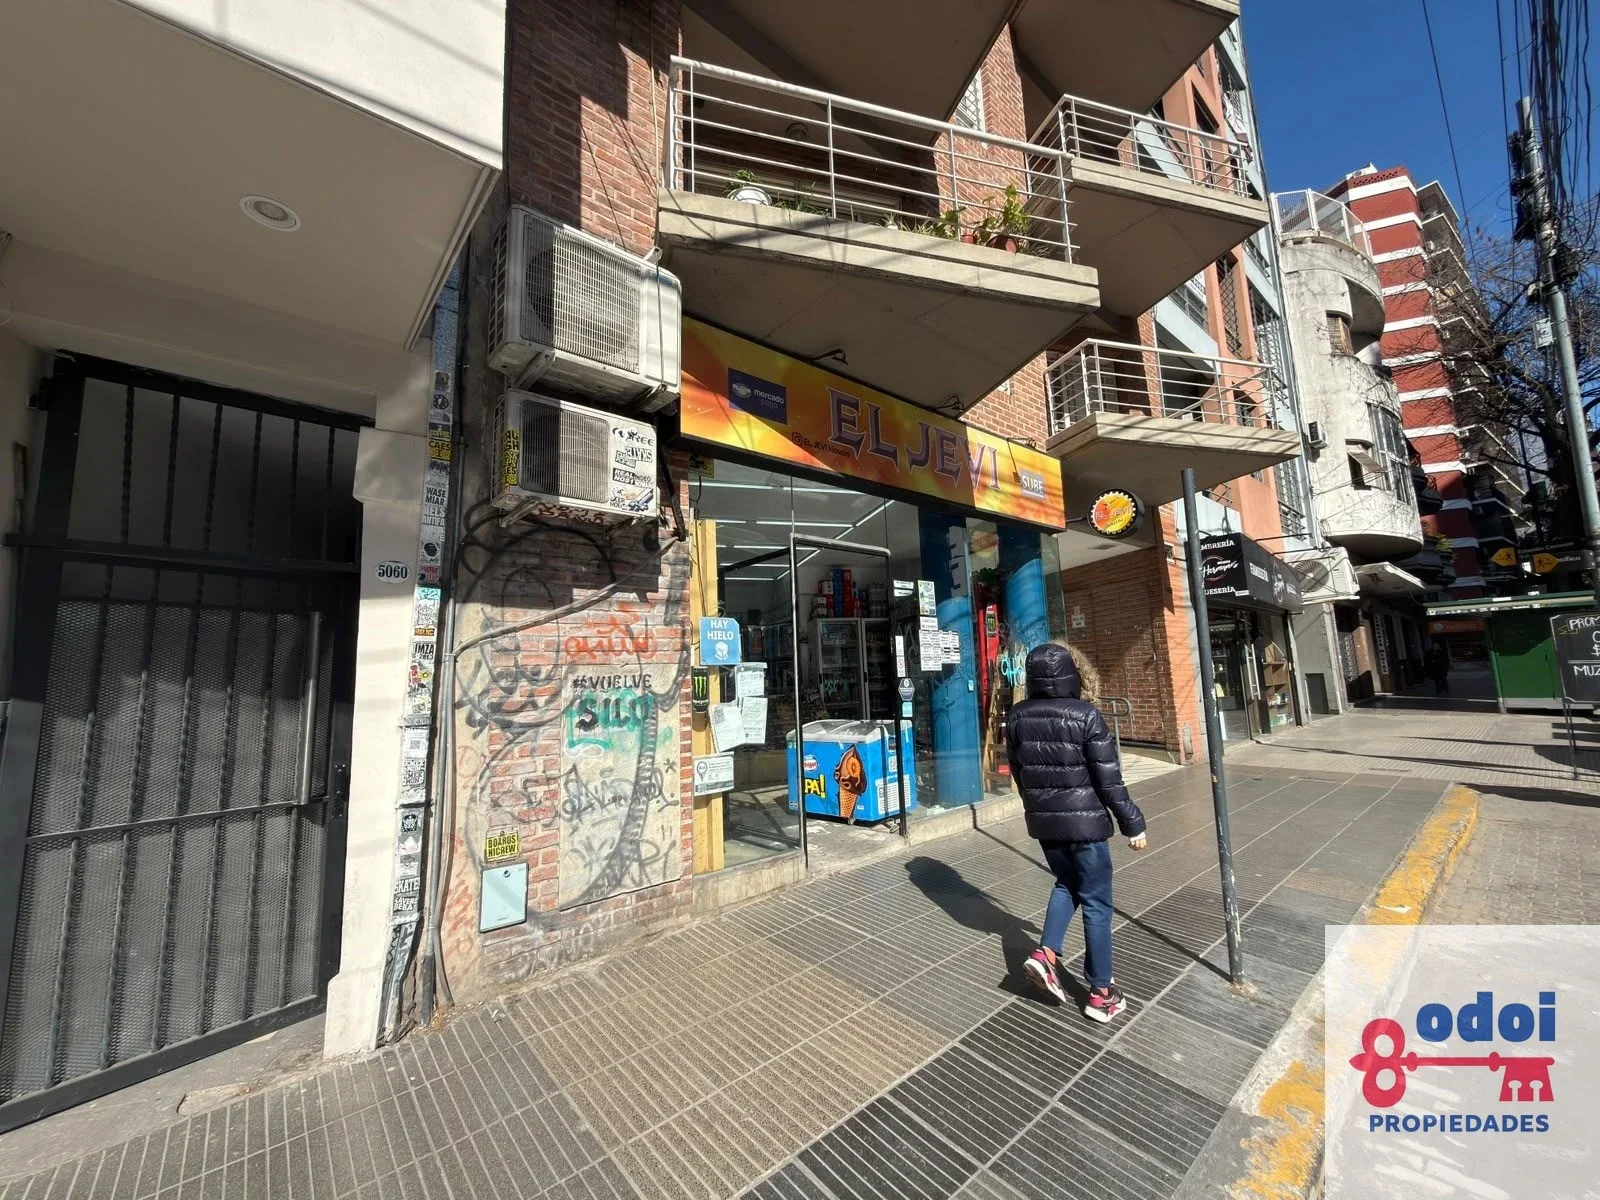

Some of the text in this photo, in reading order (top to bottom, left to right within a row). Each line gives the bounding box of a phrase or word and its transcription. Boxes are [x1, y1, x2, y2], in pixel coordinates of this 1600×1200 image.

[753, 388, 785, 404] mercado
[825, 386, 1000, 491] EL JEVI
[1021, 474, 1045, 495] SUBE
[1200, 538, 1235, 551] MBRERÍA
[378, 564, 408, 579] 5060
[1204, 585, 1236, 596] UESERÍA
[710, 619, 729, 629] HAY
[707, 630, 734, 640] HIELO
[570, 673, 652, 691] #VUELVE
[488, 834, 516, 849] BOARDS
